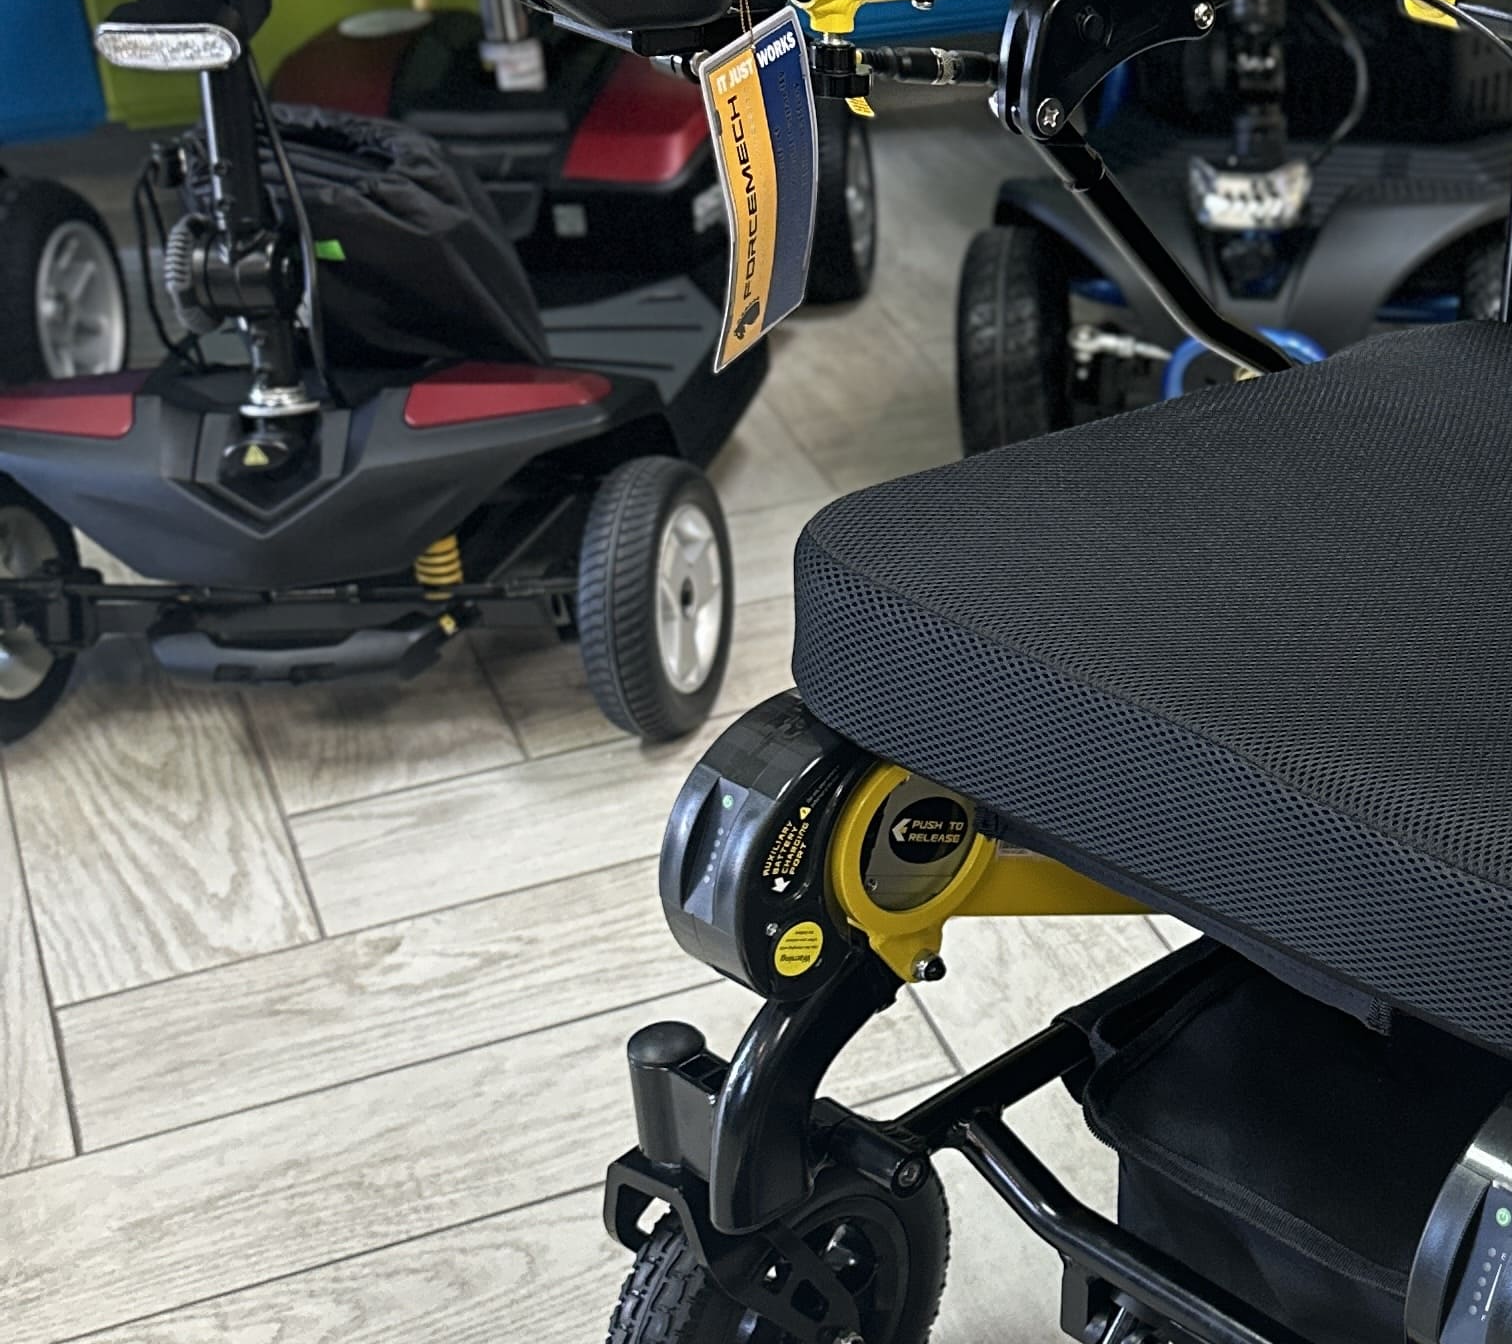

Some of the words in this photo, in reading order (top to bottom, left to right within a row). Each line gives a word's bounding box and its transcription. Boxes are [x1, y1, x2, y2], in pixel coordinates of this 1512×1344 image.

[716, 75, 728, 94] IT
[729, 57, 755, 88] JUST
[756, 31, 796, 69] WORKS
[727, 95, 759, 300] FORCEMECH
[762, 820, 794, 877] AUXILIARY
[772, 826, 800, 875] BATTERY
[908, 832, 962, 844] RELEASE
[912, 819, 944, 831] PUSH
[949, 821, 965, 831] TO
